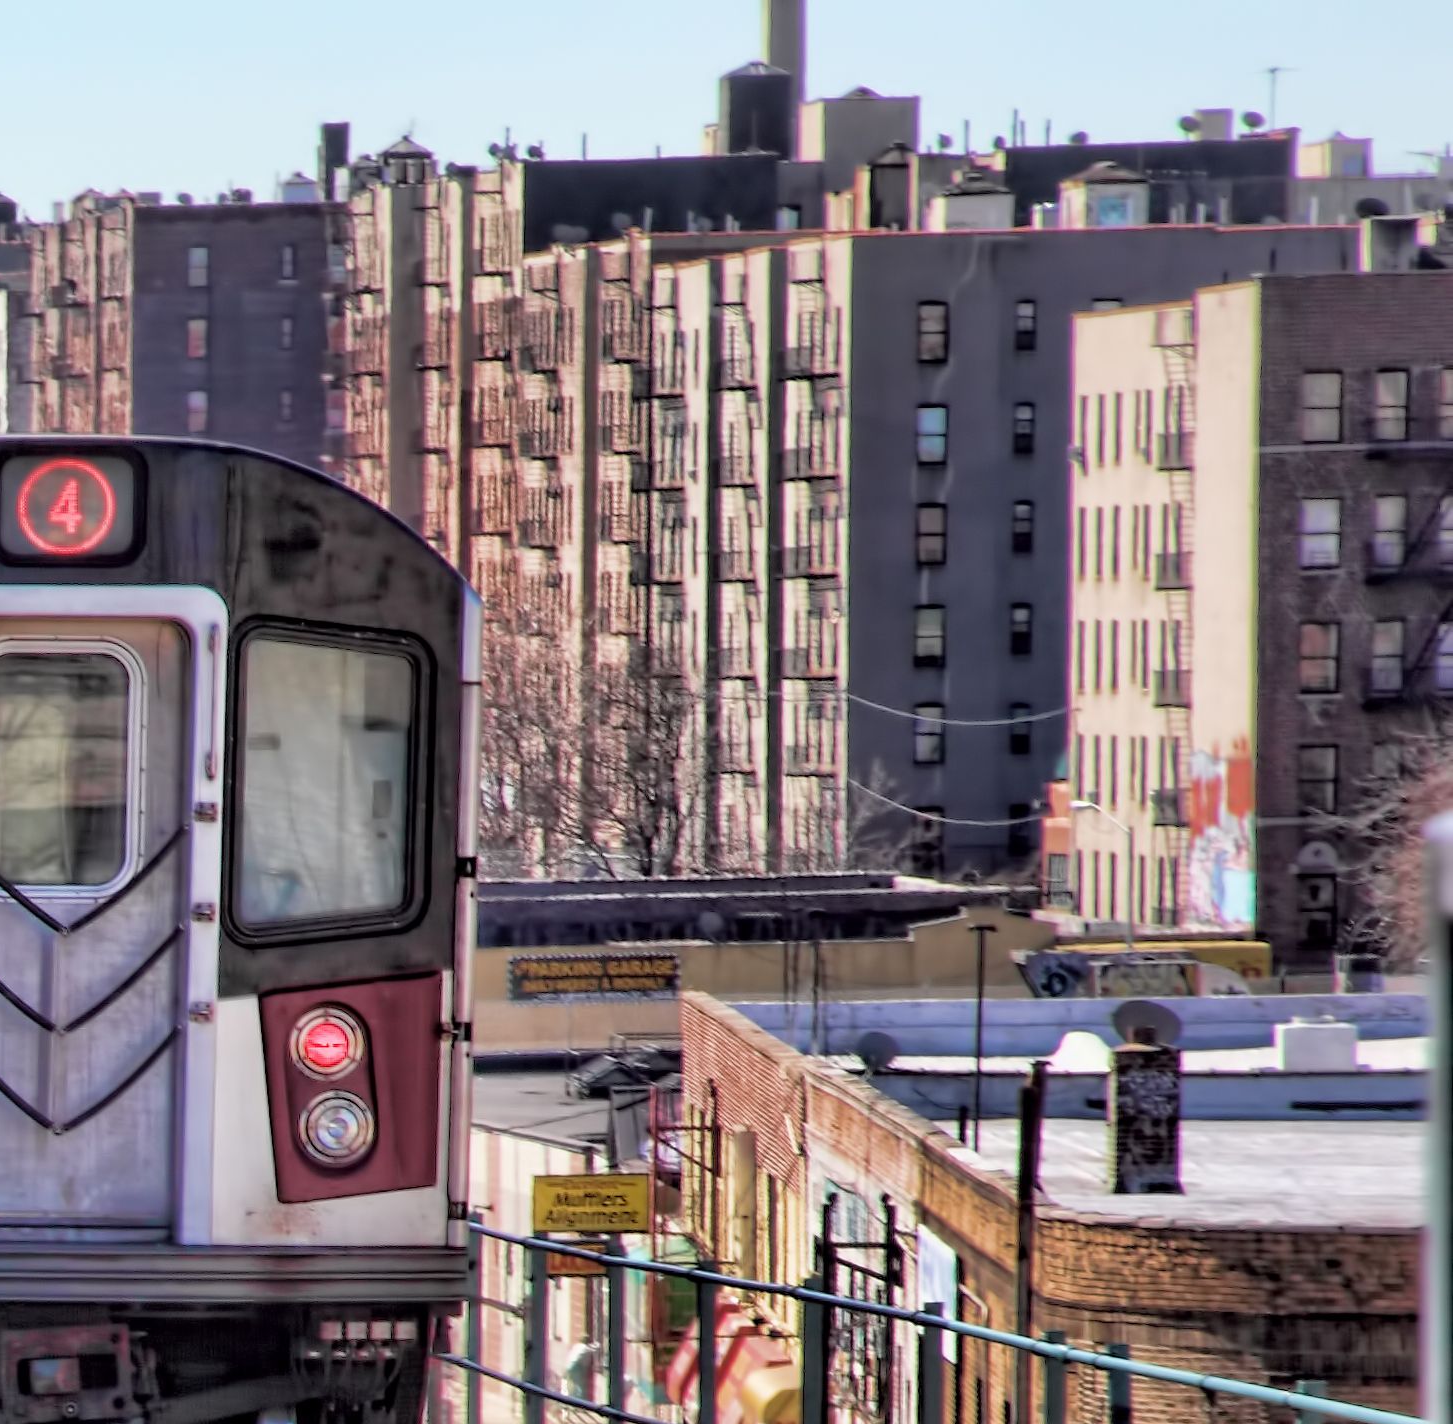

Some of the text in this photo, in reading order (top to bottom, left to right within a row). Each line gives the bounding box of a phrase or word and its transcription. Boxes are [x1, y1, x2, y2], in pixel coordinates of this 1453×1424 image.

[47, 477, 83, 534] 4
[606, 958, 675, 976] GARAGE
[553, 1192, 628, 1207] Mufflers
[544, 1210, 639, 1227] Alignment
